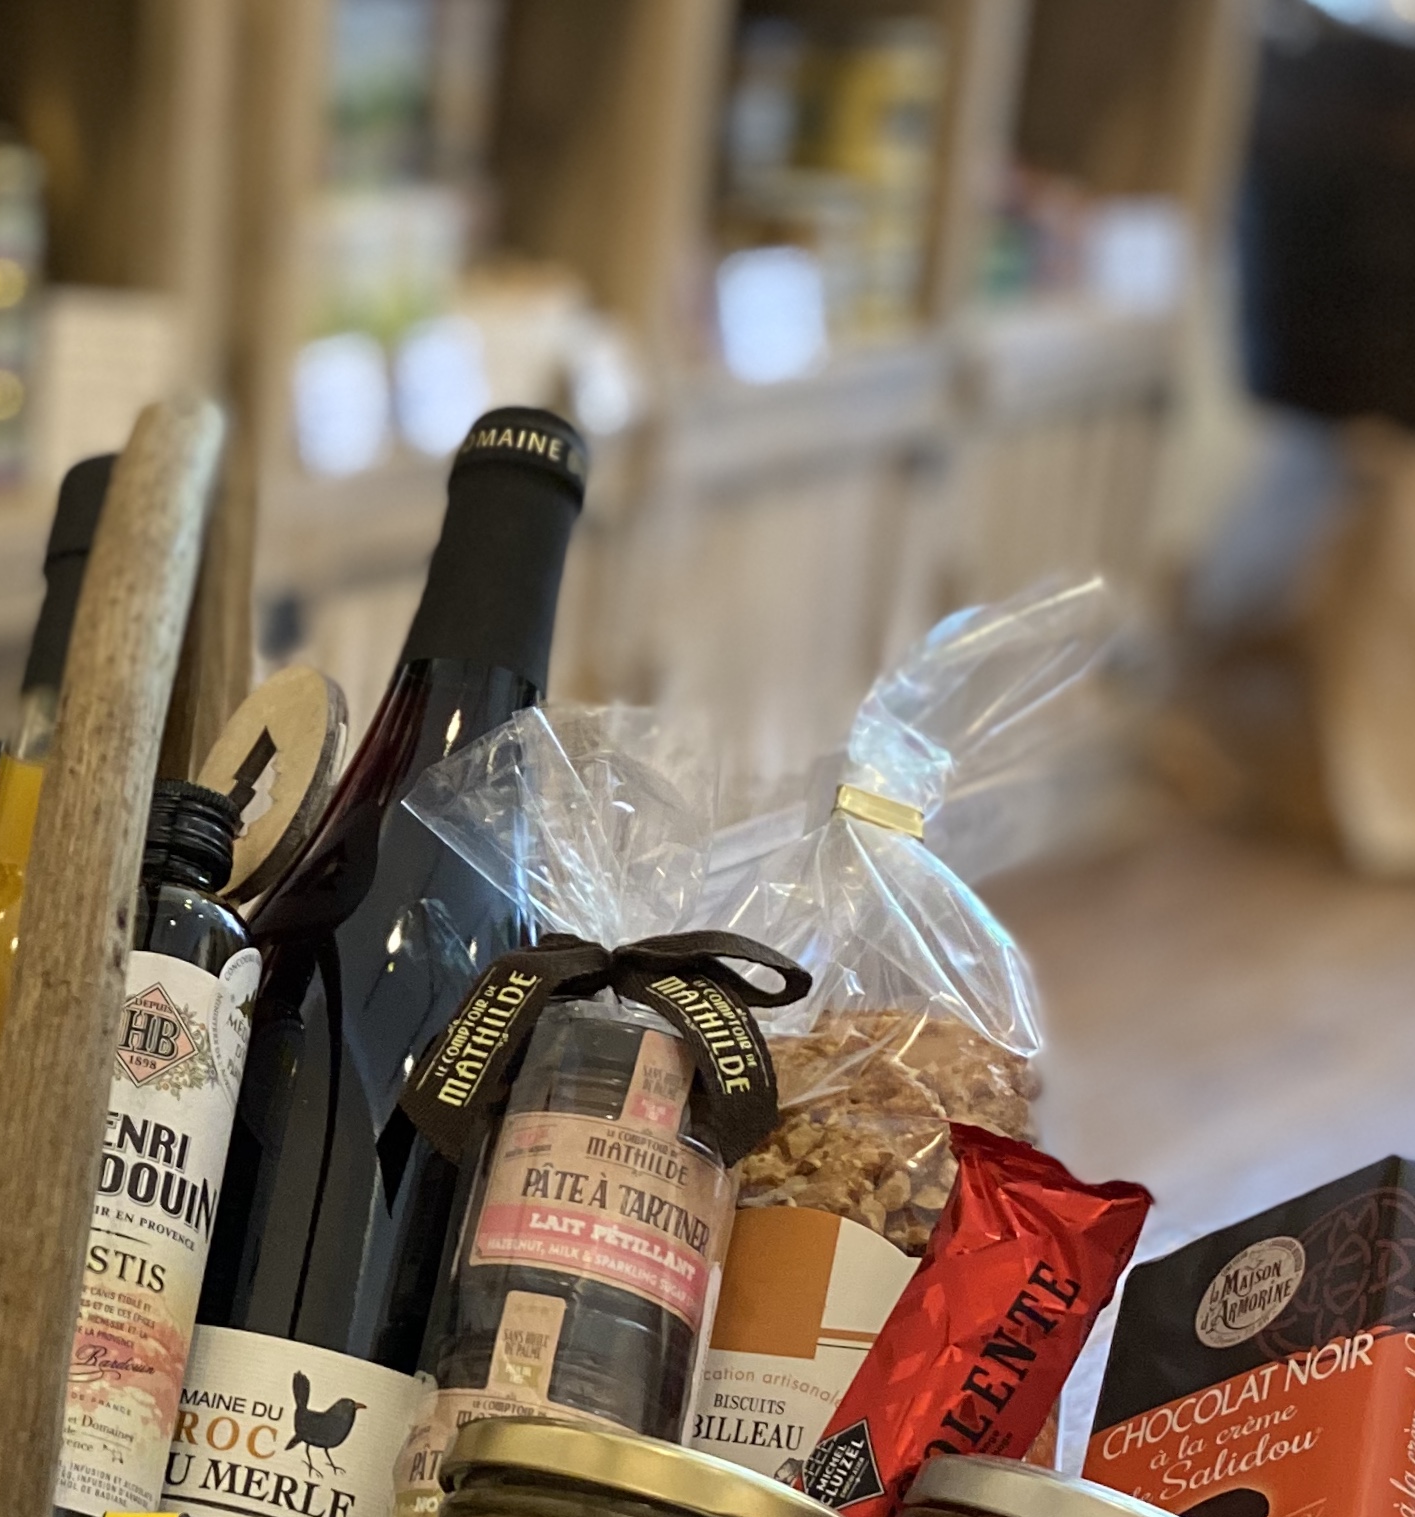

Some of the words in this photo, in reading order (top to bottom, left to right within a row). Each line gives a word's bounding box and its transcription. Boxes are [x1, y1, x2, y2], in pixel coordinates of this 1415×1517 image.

[134, 997, 174, 1015] DEPUIS
[701, 985, 753, 1051] COMPTOIR
[119, 1008, 181, 1061] HB
[437, 969, 538, 1109] MATHILDE
[443, 998, 486, 1066] COMPTOIR
[650, 974, 752, 1096] MATHILDE
[128, 1055, 158, 1071] 1898
[586, 1135, 689, 1187] MATHILDE
[617, 1130, 670, 1154] COMPTOIR
[115, 1210, 135, 1224] EN
[521, 1161, 590, 1206] PÂTE
[587, 1171, 608, 1211] À
[618, 1183, 712, 1257] TARTINER
[529, 1211, 587, 1237] LAIT
[86, 1245, 167, 1294] STIS
[594, 1253, 657, 1286] SPARKLING
[702, 1368, 756, 1385] cation
[1102, 1361, 1279, 1462] CHOCOLAT
[1283, 1332, 1375, 1393] NOIR
[251, 1401, 284, 1422] DU
[712, 1392, 787, 1417] BISCUITS
[1149, 1448, 1168, 1471] à
[1177, 1433, 1209, 1462] la
[1215, 1403, 1299, 1445] crème
[70, 1461, 112, 1482] INFUSION
[76, 1473, 117, 1493] INFUSION
[816, 1443, 848, 1492] MICHEL
[1159, 1430, 1320, 1503] Salidou
